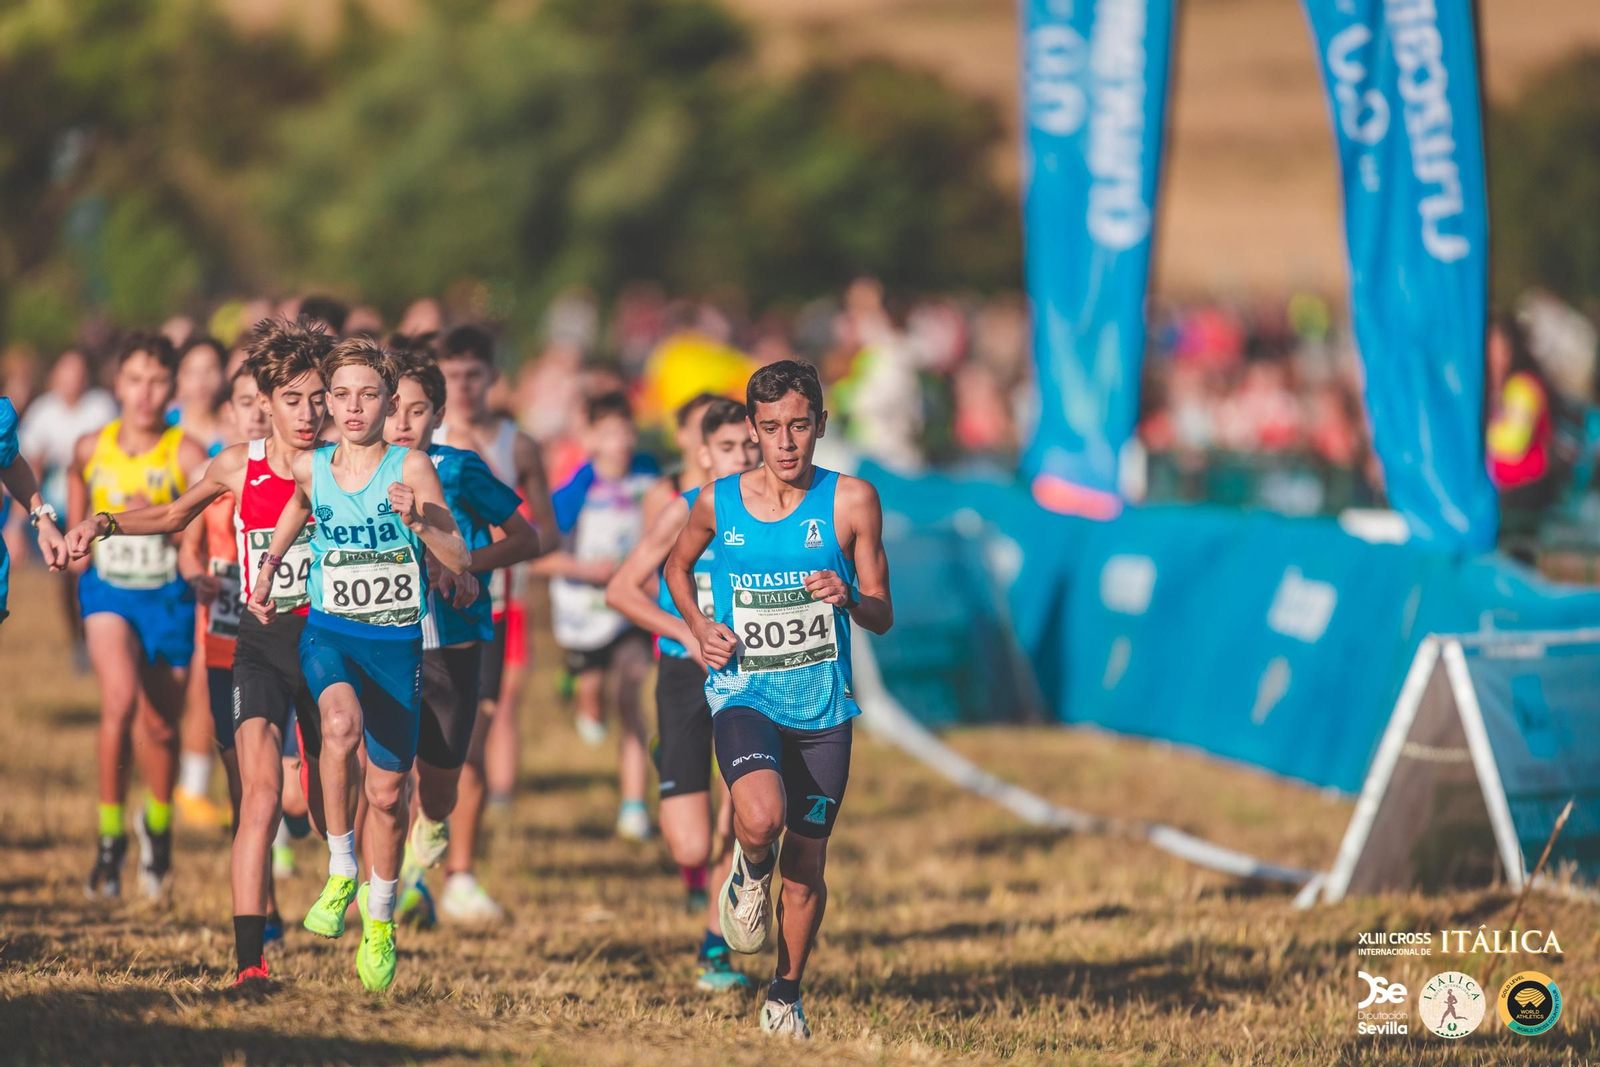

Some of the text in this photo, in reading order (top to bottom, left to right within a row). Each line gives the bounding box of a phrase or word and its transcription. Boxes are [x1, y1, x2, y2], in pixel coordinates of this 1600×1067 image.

[723, 526, 745, 545] als
[333, 574, 412, 607] 8028
[758, 591, 805, 604] ITÁLICA
[744, 614, 829, 649] 8034
